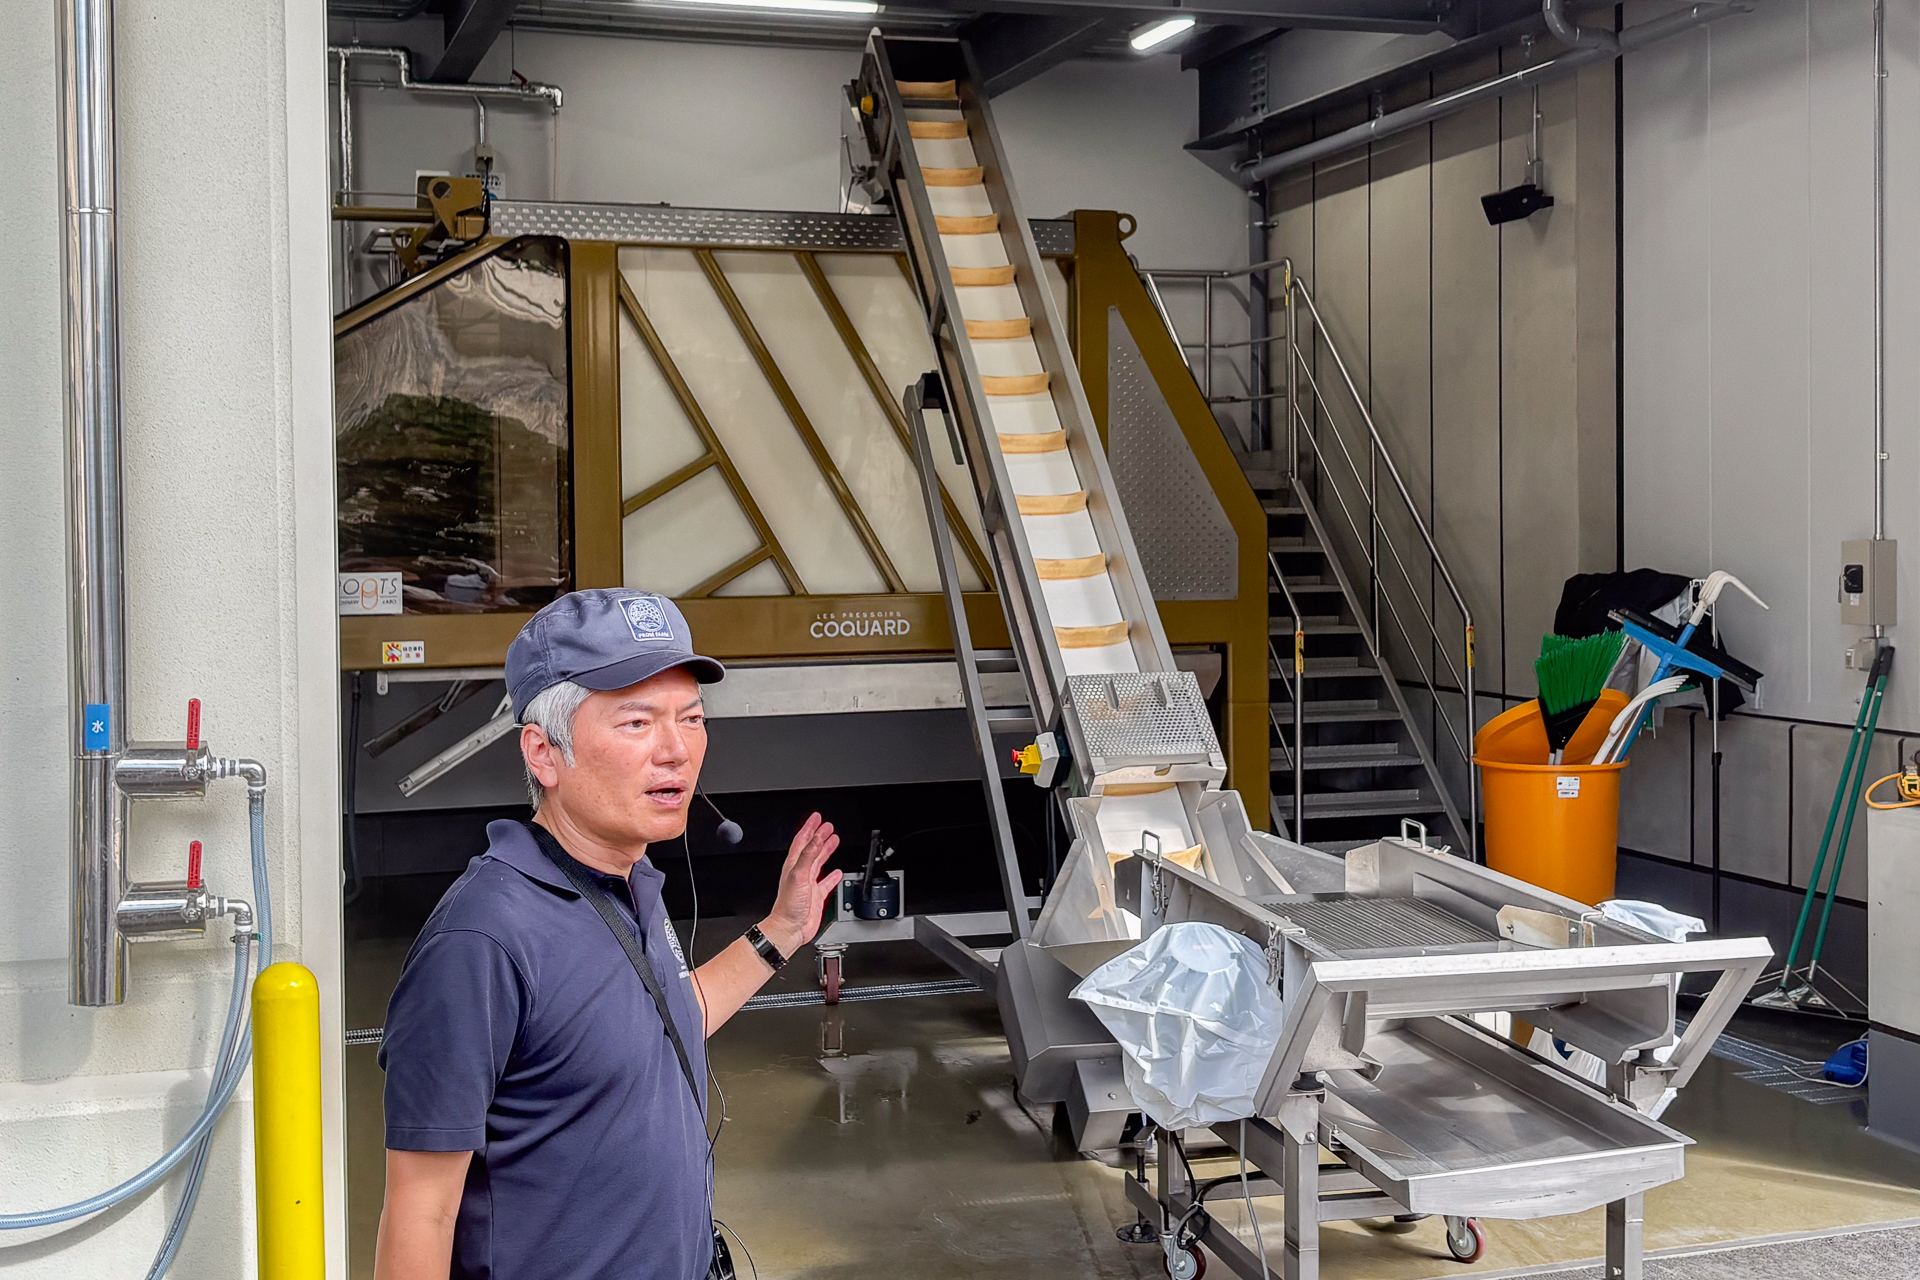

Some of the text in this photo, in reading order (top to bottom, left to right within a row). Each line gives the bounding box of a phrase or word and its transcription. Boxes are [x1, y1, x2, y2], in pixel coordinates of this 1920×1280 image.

[842, 610, 902, 618] PRESSOIRS
[810, 619, 910, 638] COQUARD
[91, 720, 104, 733] 水
